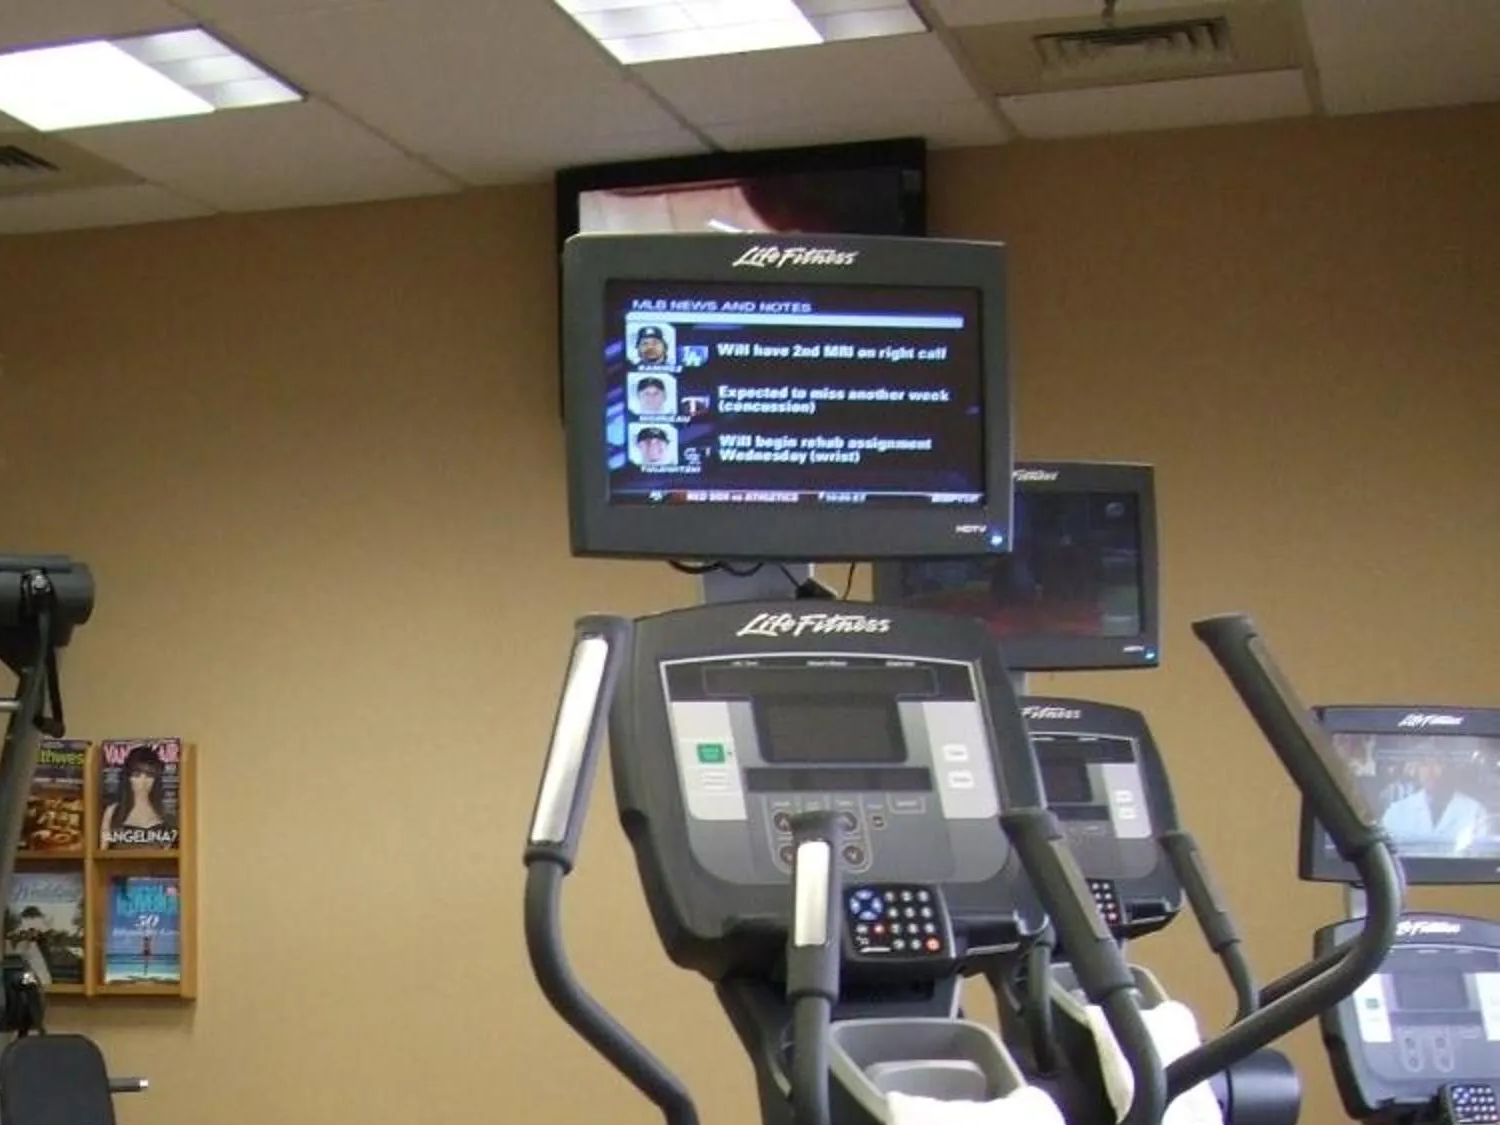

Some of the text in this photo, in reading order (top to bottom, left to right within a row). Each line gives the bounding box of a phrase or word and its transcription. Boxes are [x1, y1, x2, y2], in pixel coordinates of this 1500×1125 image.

[732, 246, 860, 268] Life Fitness
[632, 299, 812, 313] MLB NEWS AND NOTES
[717, 343, 750, 357] Will
[753, 343, 790, 358] have
[792, 345, 820, 358] 2nd
[823, 345, 854, 359] MRI
[857, 348, 877, 359] on
[878, 346, 915, 362] right
[718, 385, 950, 402] Expected to miss another week
[718, 400, 816, 415] (concussion)
[719, 434, 932, 452] Will begin rehab assignment
[719, 448, 861, 465] Wednesday (wrist)
[736, 612, 893, 637] Life Fitness
